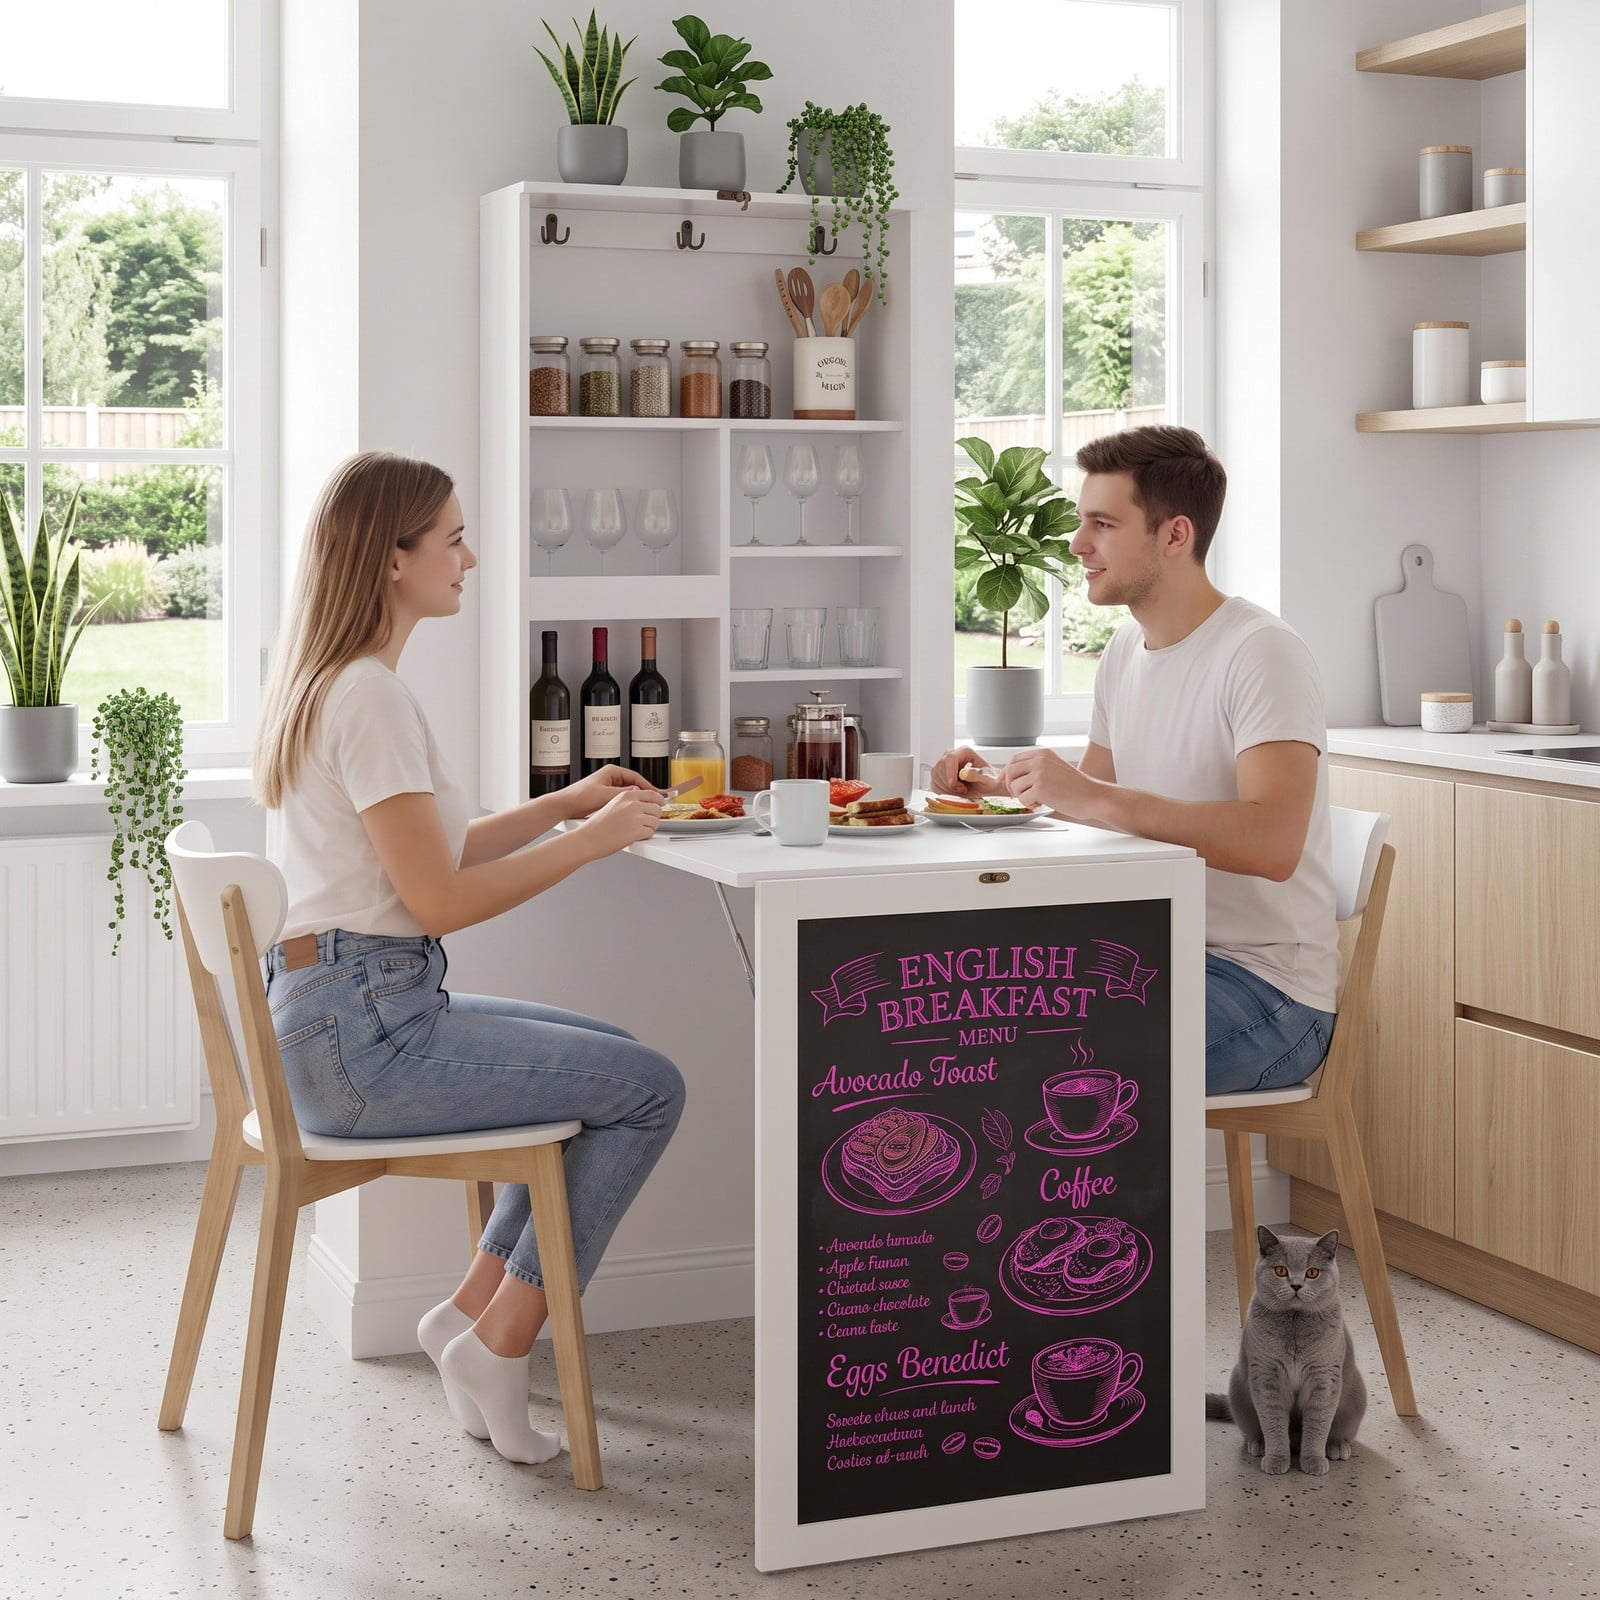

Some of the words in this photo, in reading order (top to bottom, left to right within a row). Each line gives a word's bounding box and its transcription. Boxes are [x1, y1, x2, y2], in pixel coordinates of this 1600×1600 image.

[898, 946, 1077, 990] ENGLISH
[877, 986, 1096, 1033] BREAKFAST
[958, 1026, 1018, 1047] MENU
[811, 1058, 925, 1098] Avocado
[929, 1055, 999, 1086] Toast
[1040, 1165, 1118, 1210] Coffee
[826, 1256, 867, 1280] Apple
[873, 1293, 932, 1313] chocolate
[826, 1353, 888, 1398] Eggs
[896, 1339, 1011, 1380] Benedict
[912, 1401, 938, 1419] and
